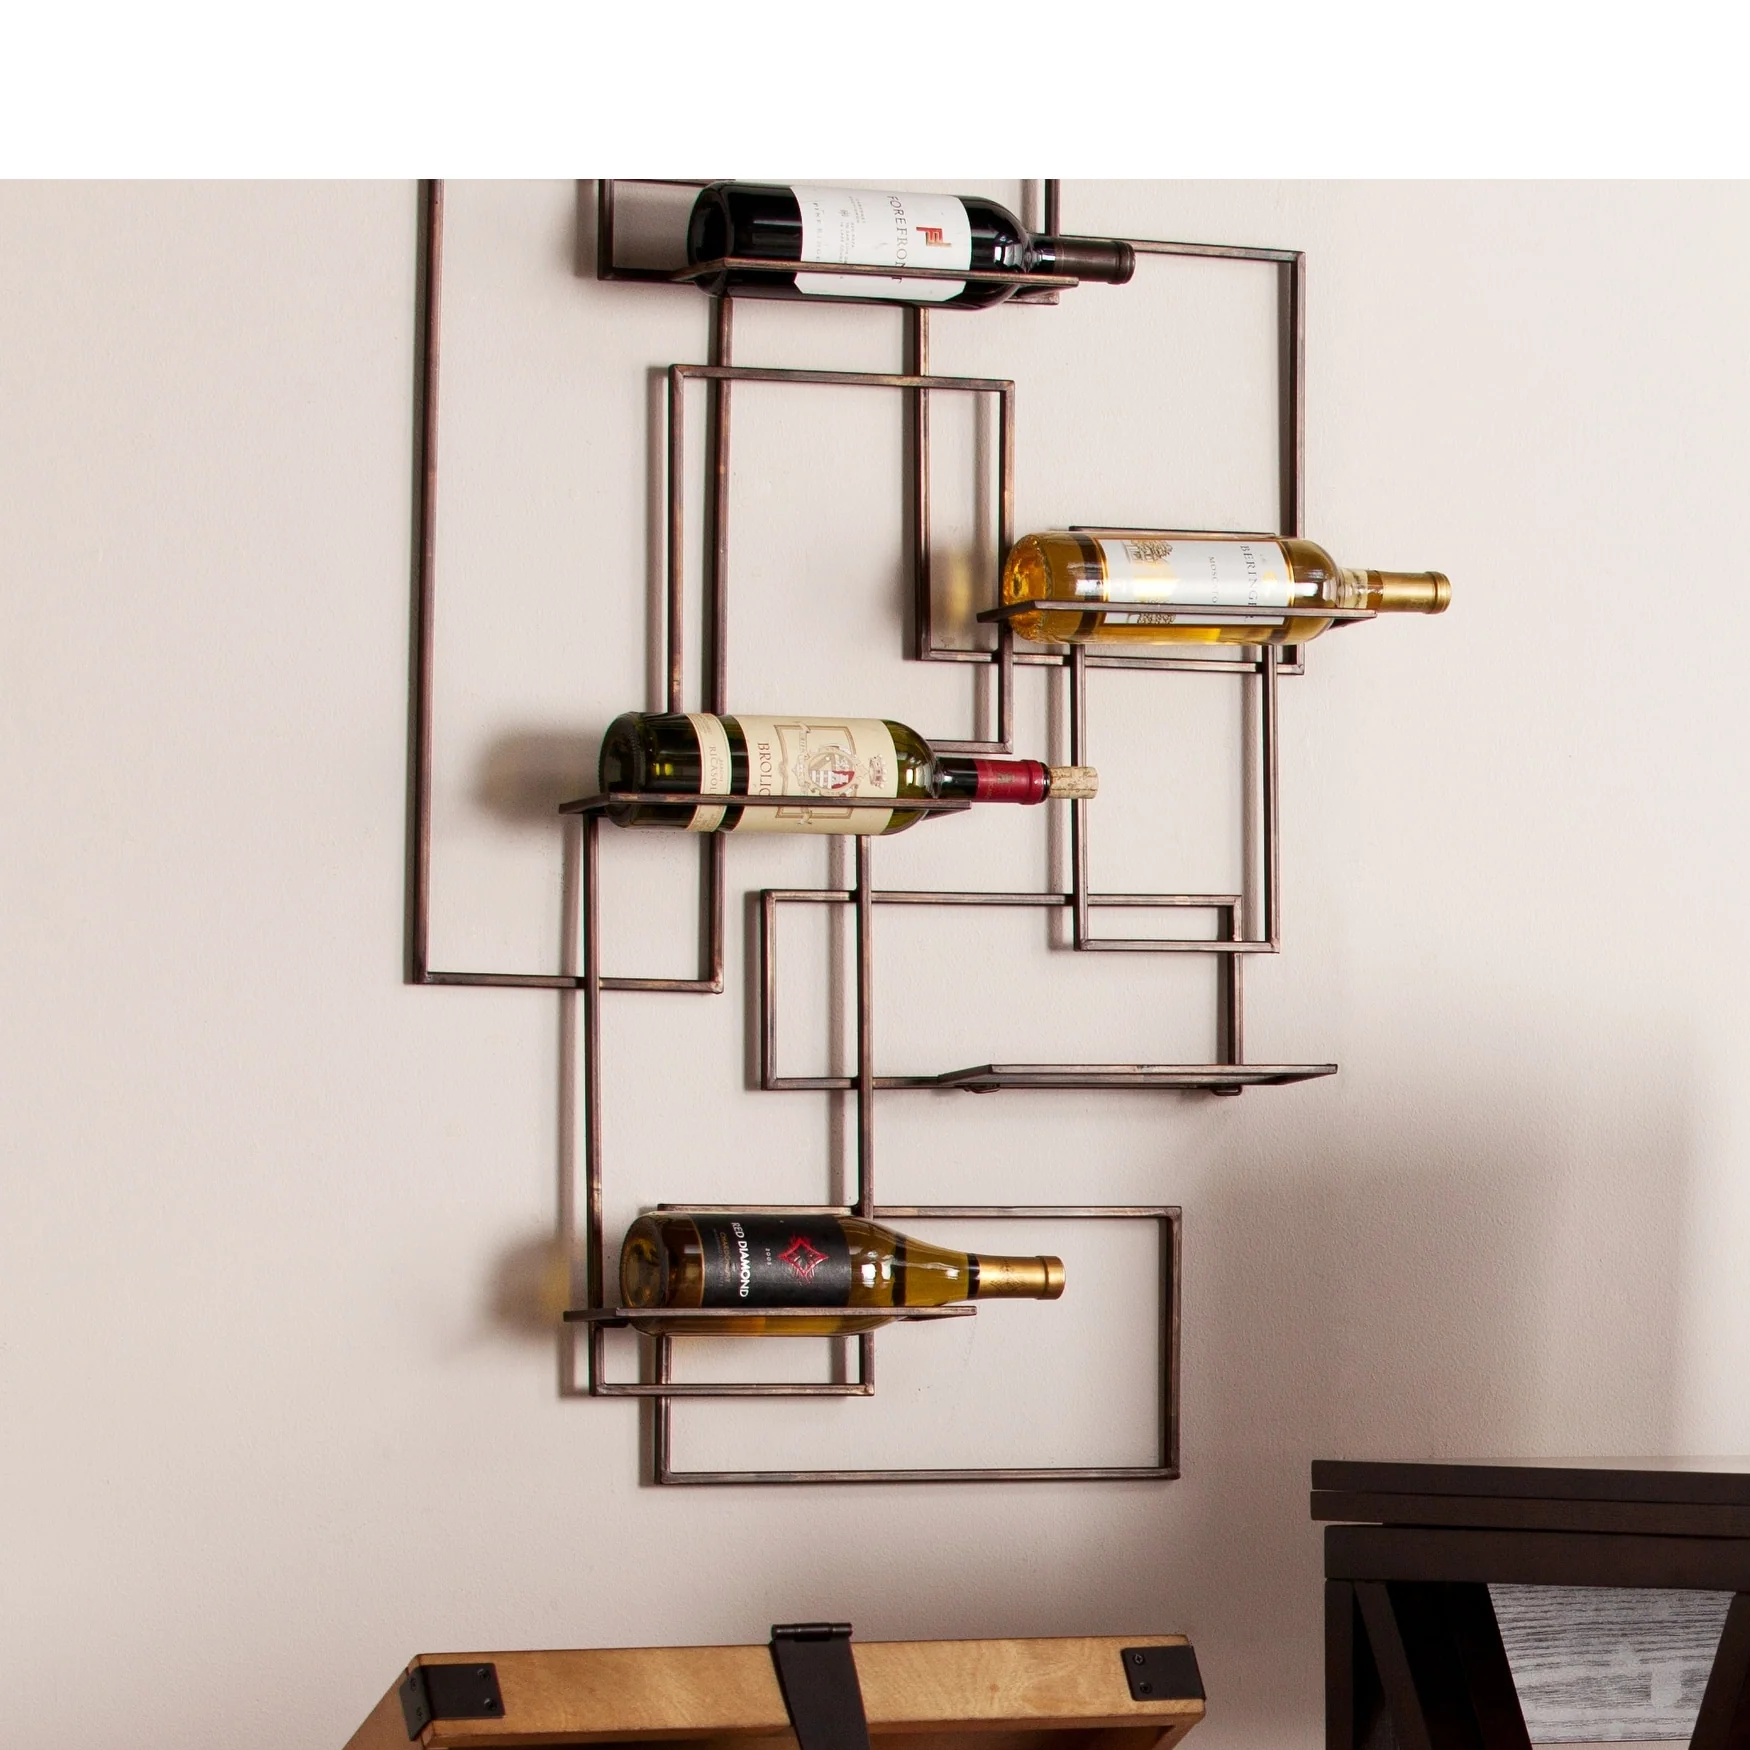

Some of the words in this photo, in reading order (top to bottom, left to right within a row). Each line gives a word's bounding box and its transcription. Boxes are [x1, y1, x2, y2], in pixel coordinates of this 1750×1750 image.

[708, 746, 719, 793] RICASOL
[731, 1222, 745, 1239] RED
[737, 1240, 751, 1298] DIAMOND
